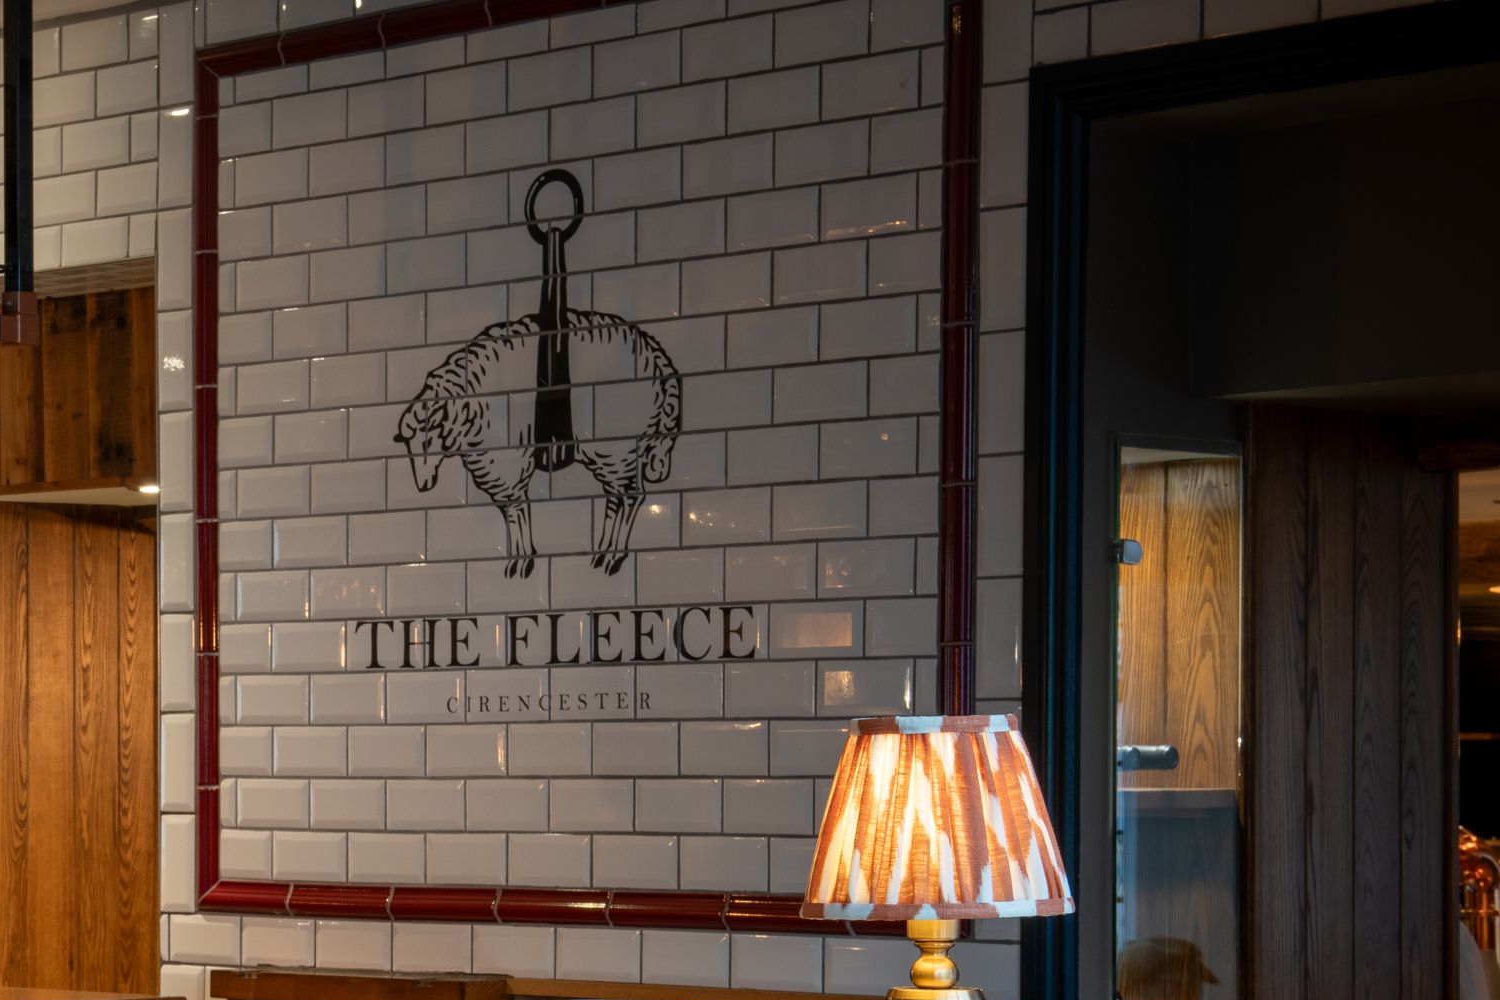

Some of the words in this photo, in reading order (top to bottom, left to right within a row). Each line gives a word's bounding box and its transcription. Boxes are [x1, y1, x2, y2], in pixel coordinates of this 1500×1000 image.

[355, 617, 481, 669] THE
[506, 605, 757, 665] FLEECE
[446, 691, 652, 714] CIRENCESTER
